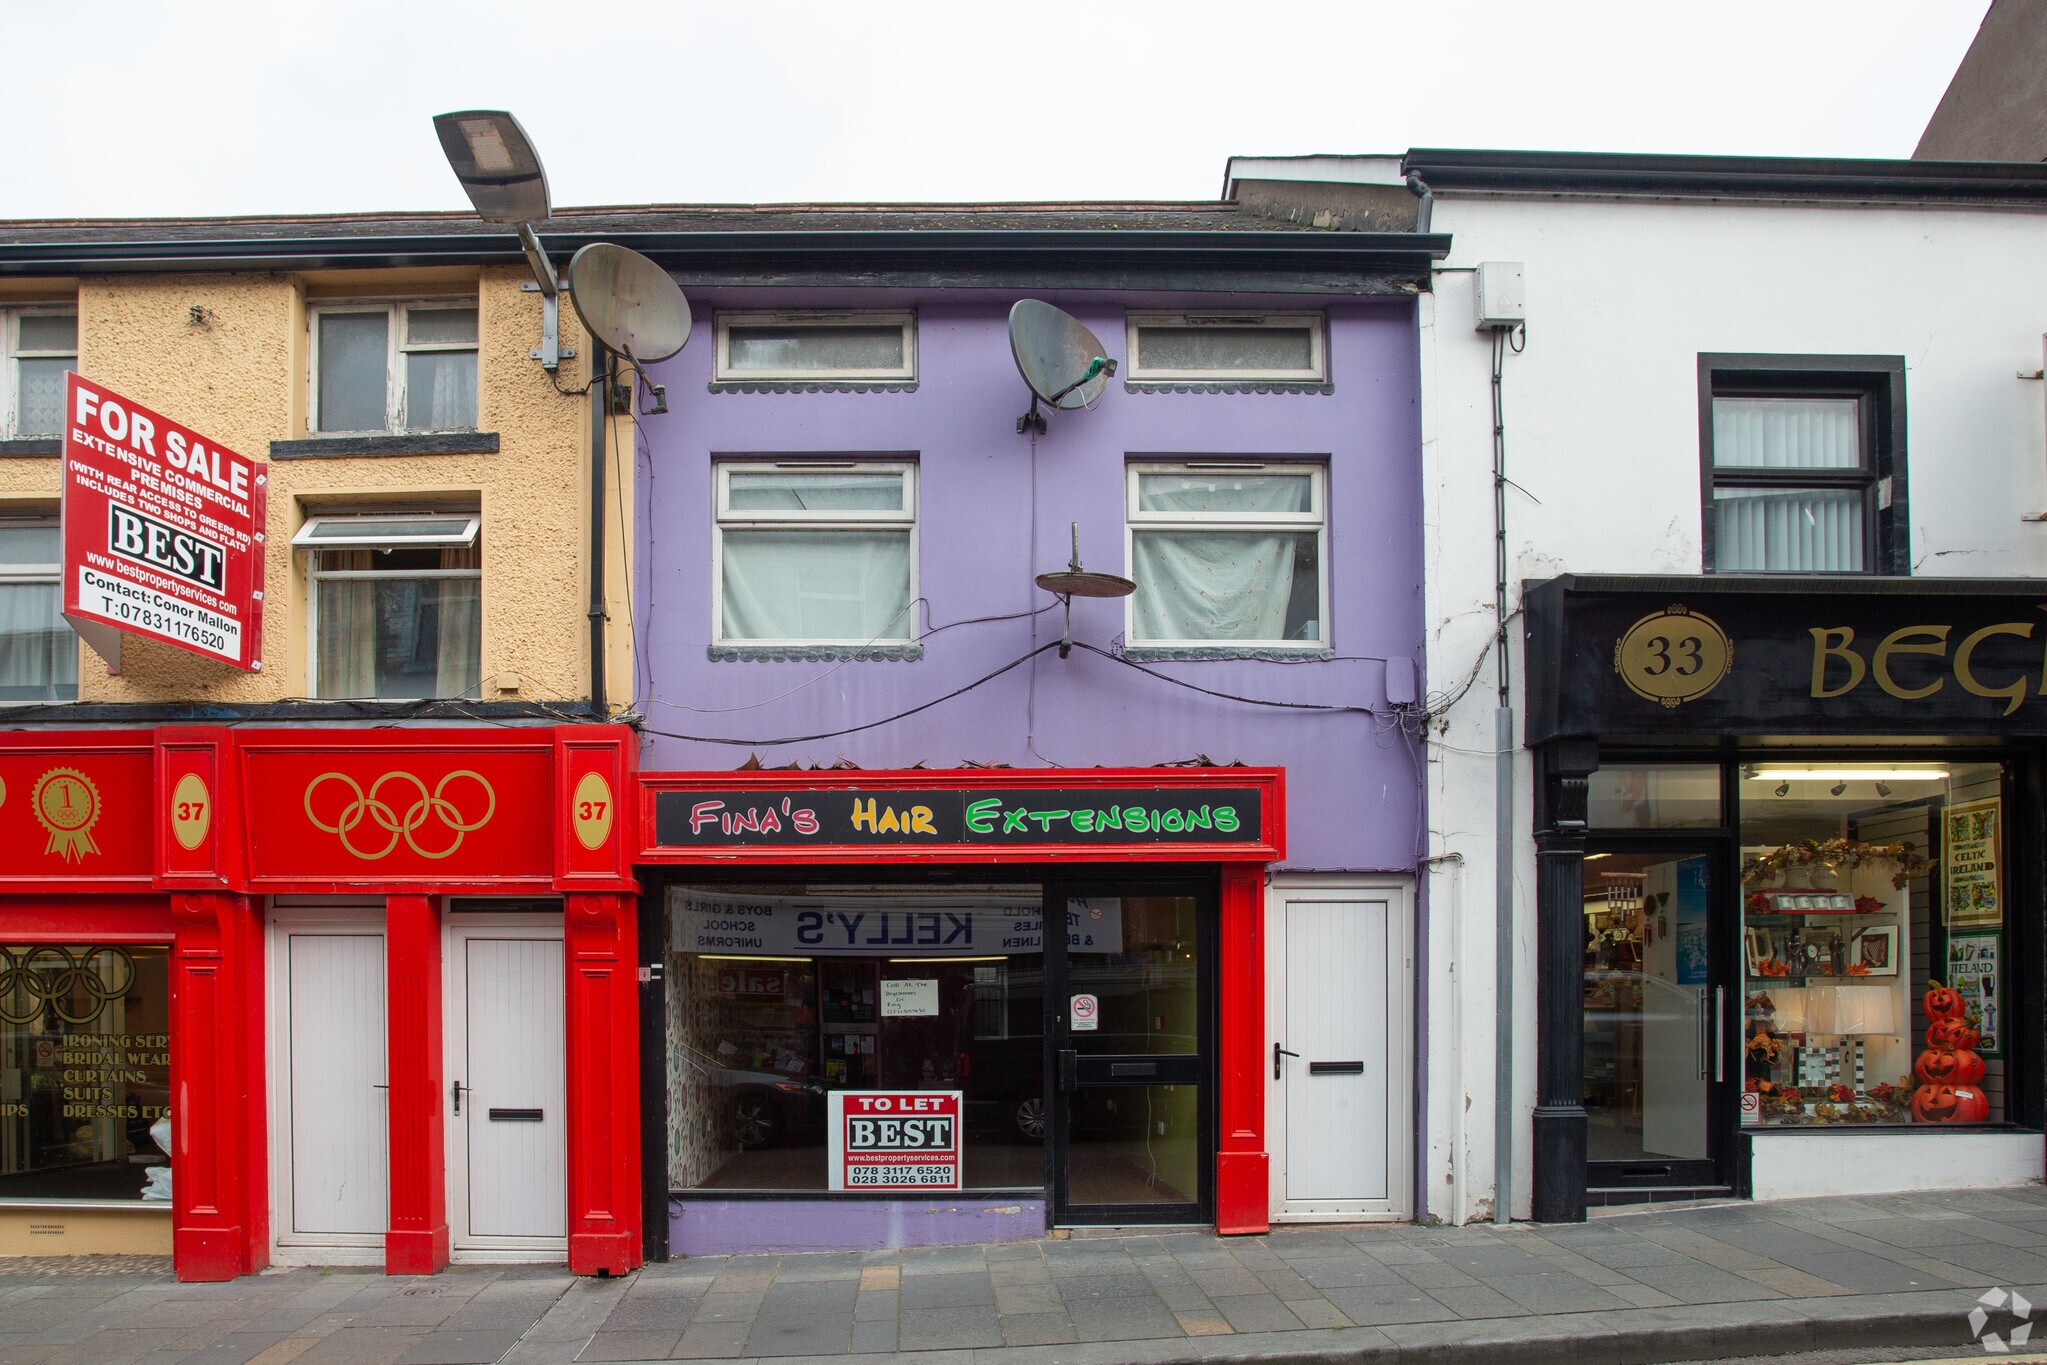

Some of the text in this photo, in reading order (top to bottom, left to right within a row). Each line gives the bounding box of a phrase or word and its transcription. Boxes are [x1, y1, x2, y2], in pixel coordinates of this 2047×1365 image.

[76, 386, 249, 500] FOR SALE
[72, 429, 250, 519] EXTENSIVE COMMERCIAL
[131, 468, 203, 510] PREMISES
[69, 459, 251, 546] (WITH REAR ACCESS TO GREERS RD)
[76, 474, 247, 553] INCLUDES TWO SHOPS AND FLATS
[114, 509, 222, 585] BEST
[84, 571, 238, 635] Contact: Conor Mallon
[101, 595, 224, 651] T:07831176520
[1643, 635, 1704, 677] 33
[1809, 603, 2047, 717] BEG
[59, 784, 74, 808] 1
[177, 802, 205, 822] 37
[579, 802, 607, 821] 37
[689, 797, 1239, 835] FINA'S HAIR EXTENSIONS
[1954, 850, 1986, 862] CELTIC
[1950, 861, 1995, 875] IRELAND
[63, 1034, 131, 1048] IRONING
[62, 1052, 124, 1065] BRIDAL
[127, 1052, 171, 1066] WEAR
[63, 1070, 147, 1083] CURTAINS
[63, 1087, 112, 1100] SUITS
[859, 1098, 944, 1111] TO LET
[63, 1105, 138, 1118] DRESSES
[852, 1120, 949, 1147] BEST
[848, 1154, 955, 1162] www.bestpropertyservices.com
[852, 1175, 950, 1184] 028 3026 6811
[853, 1166, 951, 1175] 078 3117 6520
